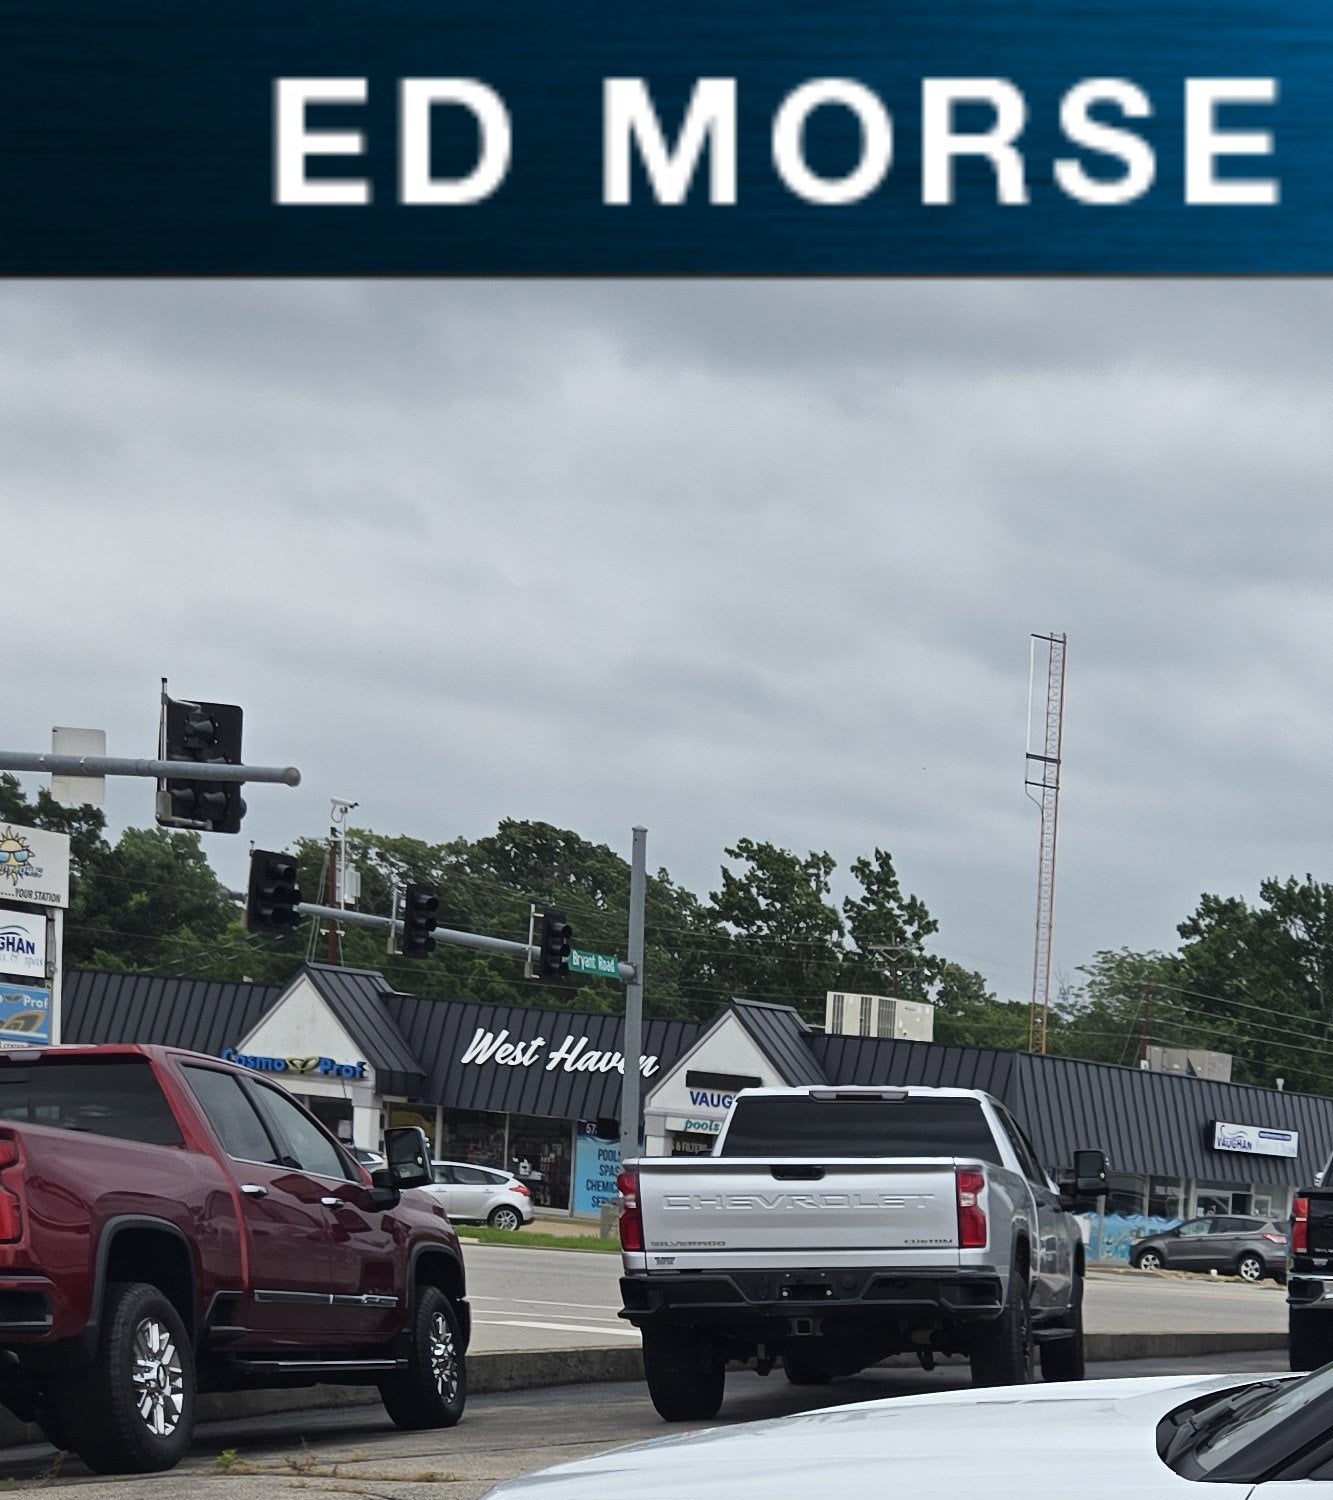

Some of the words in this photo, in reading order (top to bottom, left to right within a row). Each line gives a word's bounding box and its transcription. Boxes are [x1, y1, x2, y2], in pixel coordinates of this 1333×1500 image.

[572, 950, 596, 971] Bryant
[598, 955, 615, 973] Road
[461, 1027, 546, 1067] West
[546, 1034, 660, 1078] Havn
[319, 1056, 366, 1079] Prof
[690, 1090, 736, 1109] VAUG
[684, 1119, 720, 1132] pools
[586, 1179, 618, 1194] CHEMIC
[662, 1194, 935, 1210] CHEVROLET
